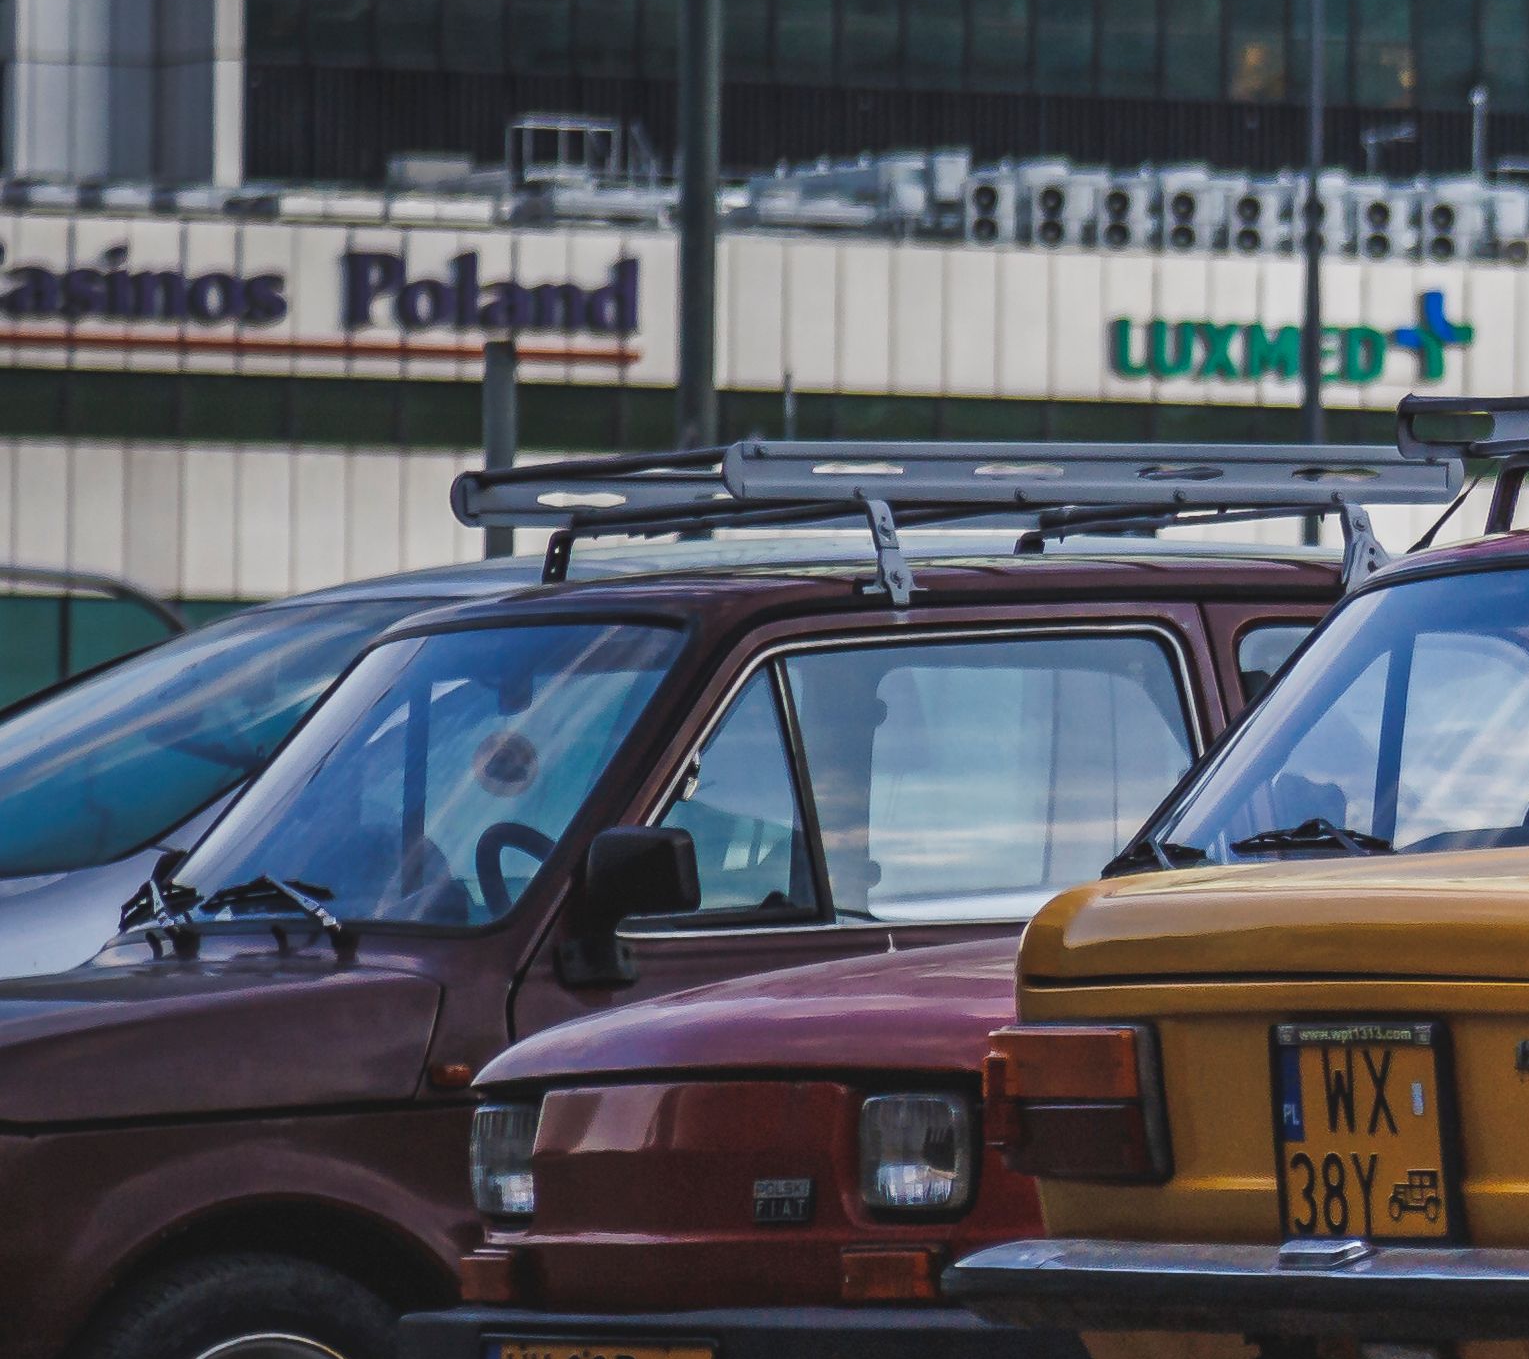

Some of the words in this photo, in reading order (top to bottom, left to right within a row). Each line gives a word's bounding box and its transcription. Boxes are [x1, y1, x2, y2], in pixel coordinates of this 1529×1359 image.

[0, 243, 288, 326] asinos
[341, 250, 640, 331] Poland
[1282, 1103, 1300, 1127] PL
[1321, 1045, 1398, 1137] WX
[756, 1199, 806, 1218] FIAT
[1290, 1151, 1379, 1237] 38Y
